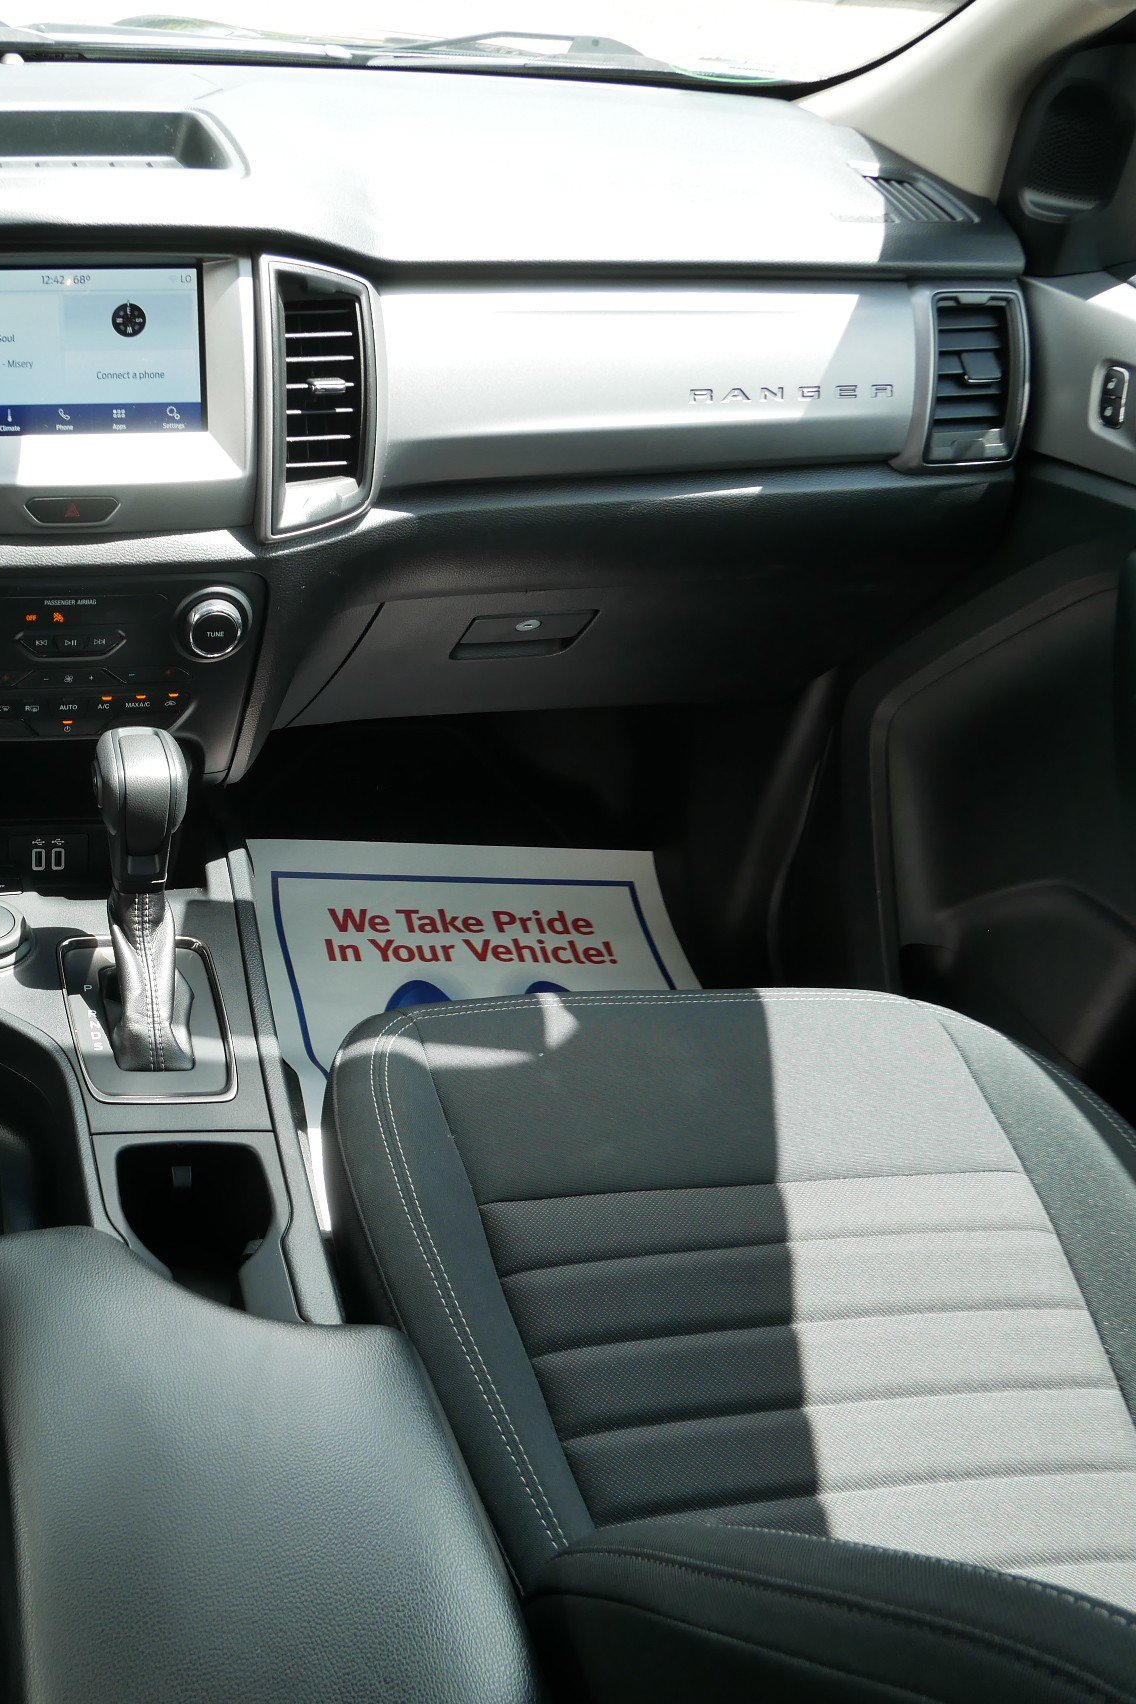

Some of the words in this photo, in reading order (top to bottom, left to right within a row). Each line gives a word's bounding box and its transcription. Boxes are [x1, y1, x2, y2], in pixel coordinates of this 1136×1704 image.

[41, 275, 64, 285] 12:42
[180, 274, 192, 284] LO
[7, 360, 33, 369] Misery
[96, 371, 130, 379] Connect
[139, 371, 164, 381] phone
[688, 384, 894, 403] RANGER
[327, 908, 390, 933] We
[395, 909, 484, 934] Take
[491, 910, 594, 936] Pride
[325, 939, 361, 962] In
[367, 939, 455, 963] Your
[463, 939, 619, 965] Vehicle!
[90, 1021, 100, 1029] N
[91, 1031, 101, 1040] D
[93, 1042, 103, 1051] S
